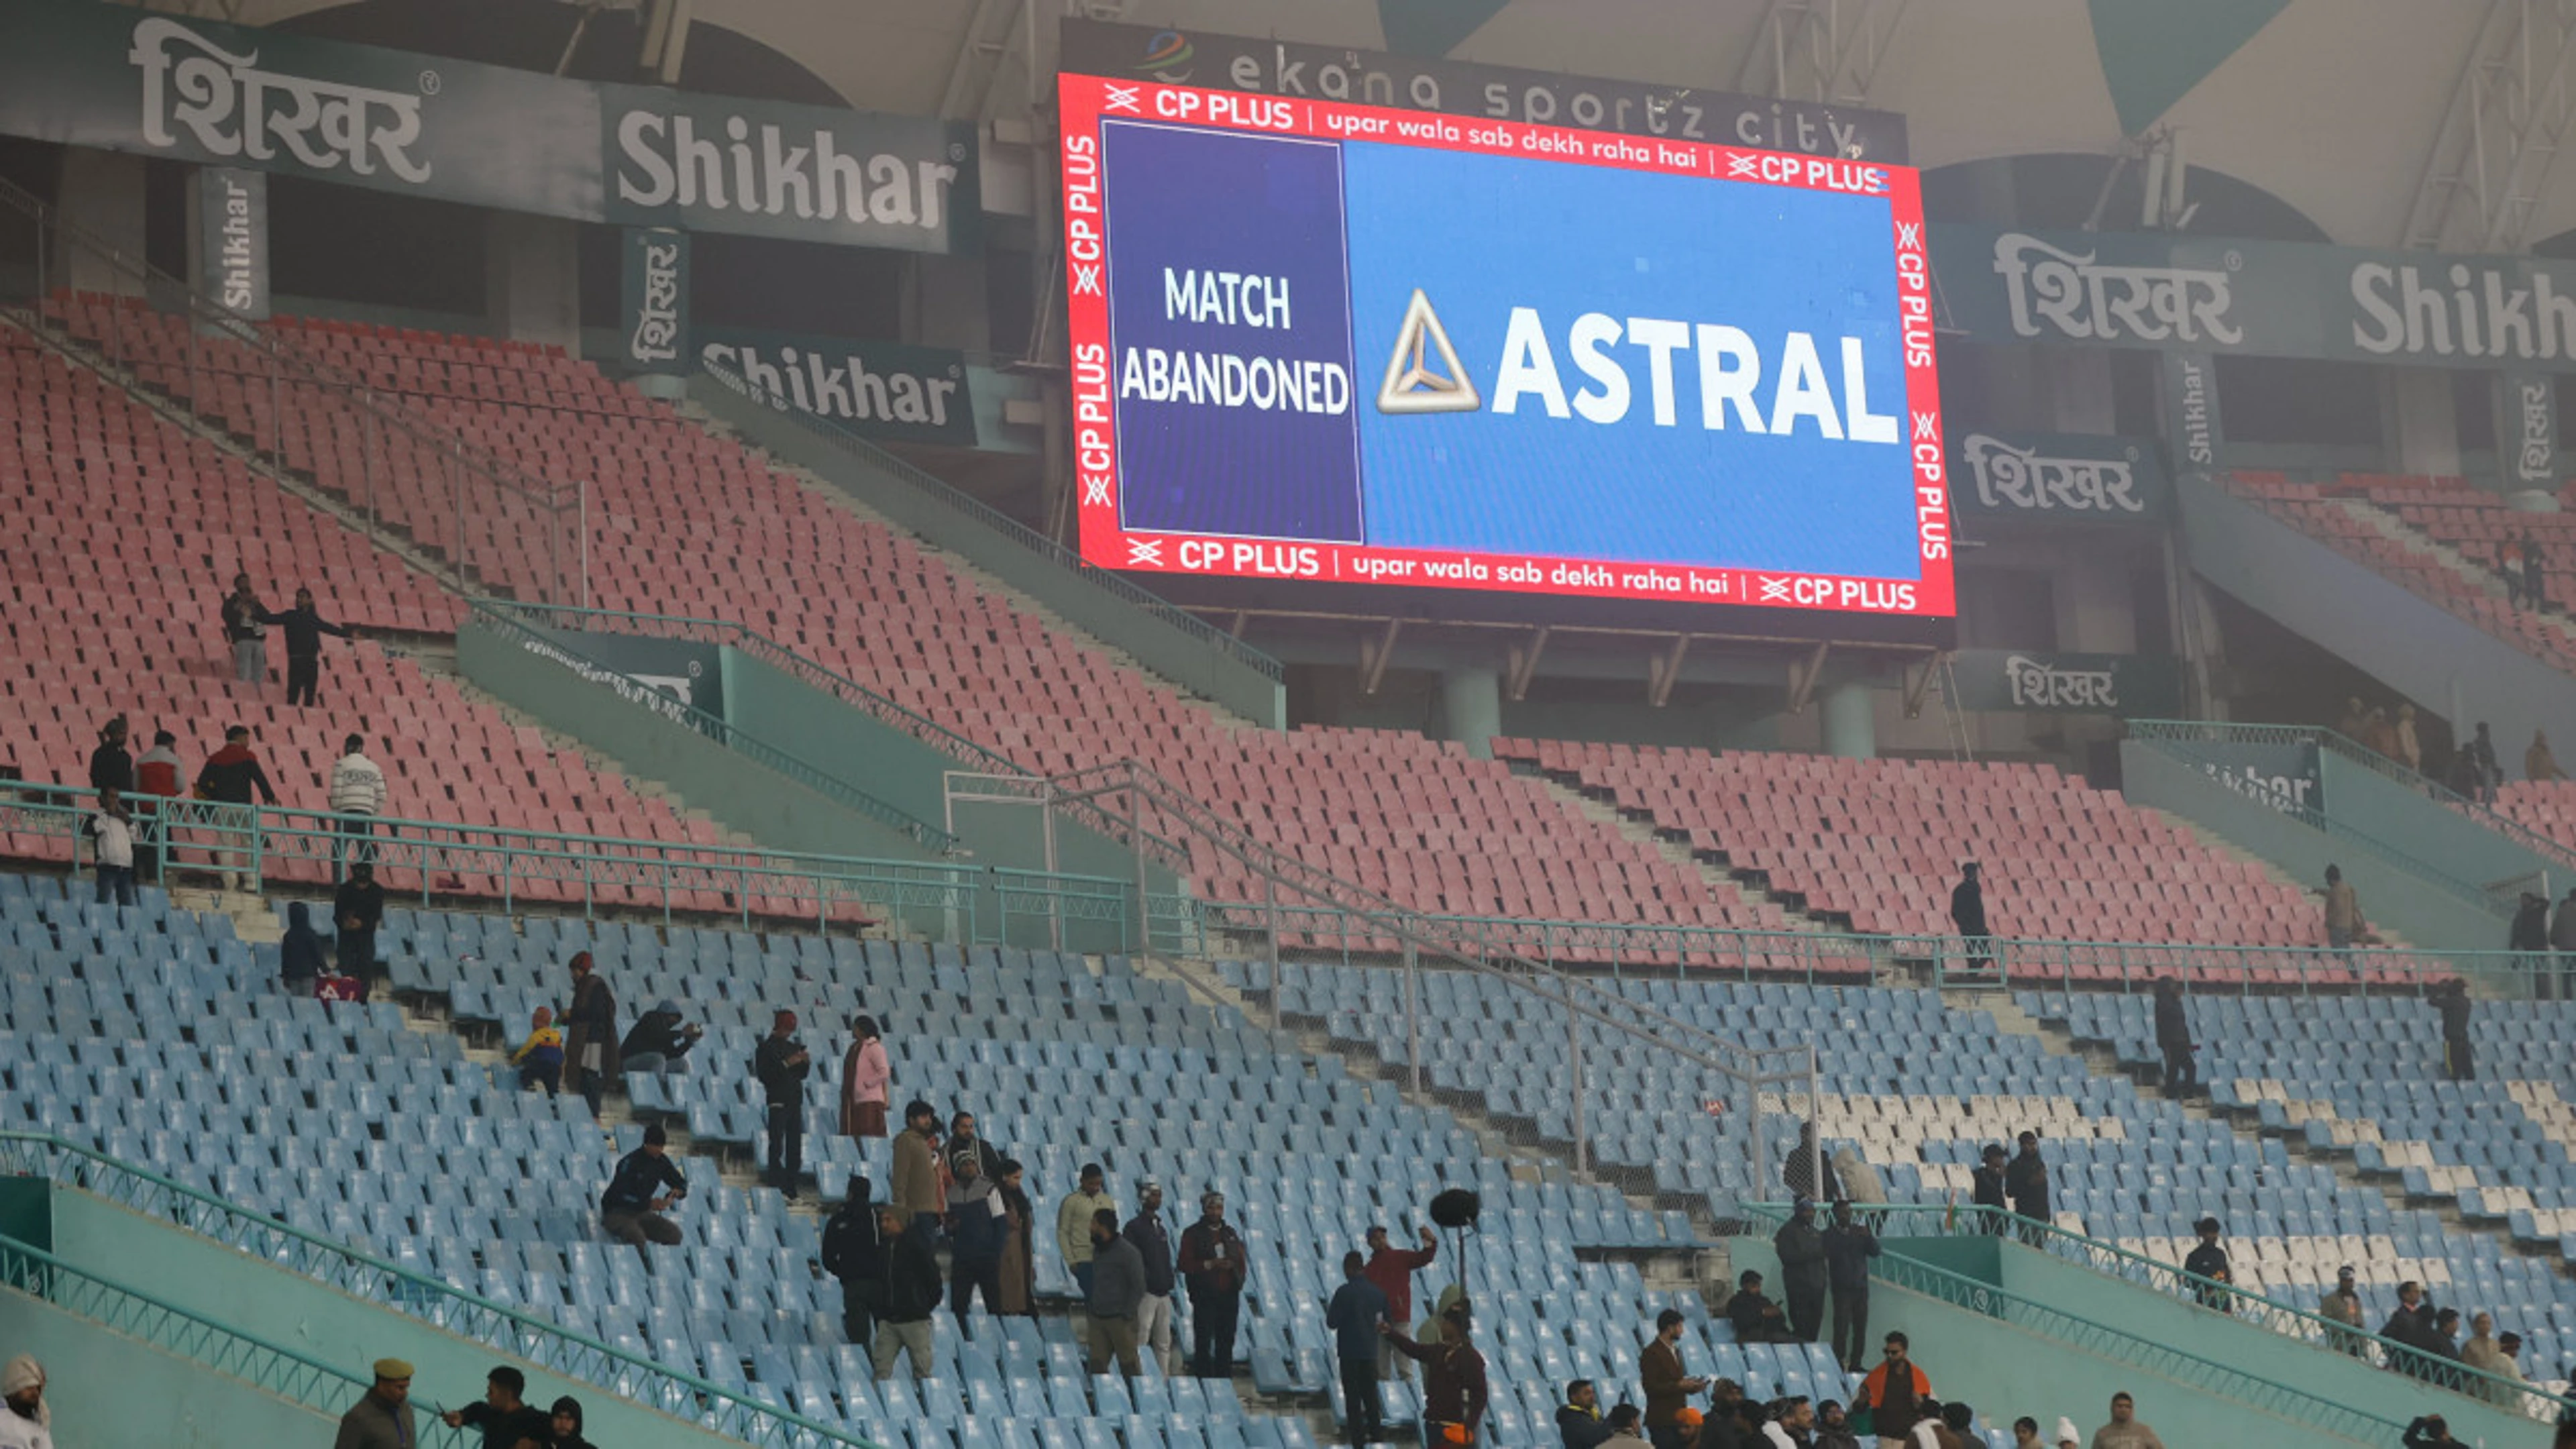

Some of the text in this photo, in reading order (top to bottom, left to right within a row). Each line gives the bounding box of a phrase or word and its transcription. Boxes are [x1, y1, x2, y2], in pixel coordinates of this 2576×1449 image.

[129, 17, 431, 183] शिखर
[1156, 89, 1882, 193] CP PLUS upar wala sab dekh raha hai CP PLUS
[1230, 44, 1856, 159] ekana sportz city
[617, 110, 957, 228] Shikhar
[1067, 136, 1100, 260] CP PLUS
[223, 180, 252, 310] Shikhar
[1165, 268, 1291, 329] MATCH
[1994, 233, 2243, 343] शिखर
[631, 244, 677, 363] शिखर
[1898, 253, 1932, 368] CP PLUS
[1076, 343, 1110, 471] CP PLUS
[1121, 347, 1349, 415] ABANDONED
[1491, 306, 1900, 444] ASTRAL
[2183, 360, 2212, 464] Shikhar
[1915, 443, 1947, 559] CP PLUS
[1964, 433, 2143, 512] शिखर
[1179, 540, 1916, 610] CP PLUS upar wala sab dekh raha hai CP PLUS
[2006, 655, 2118, 706] शिखर
